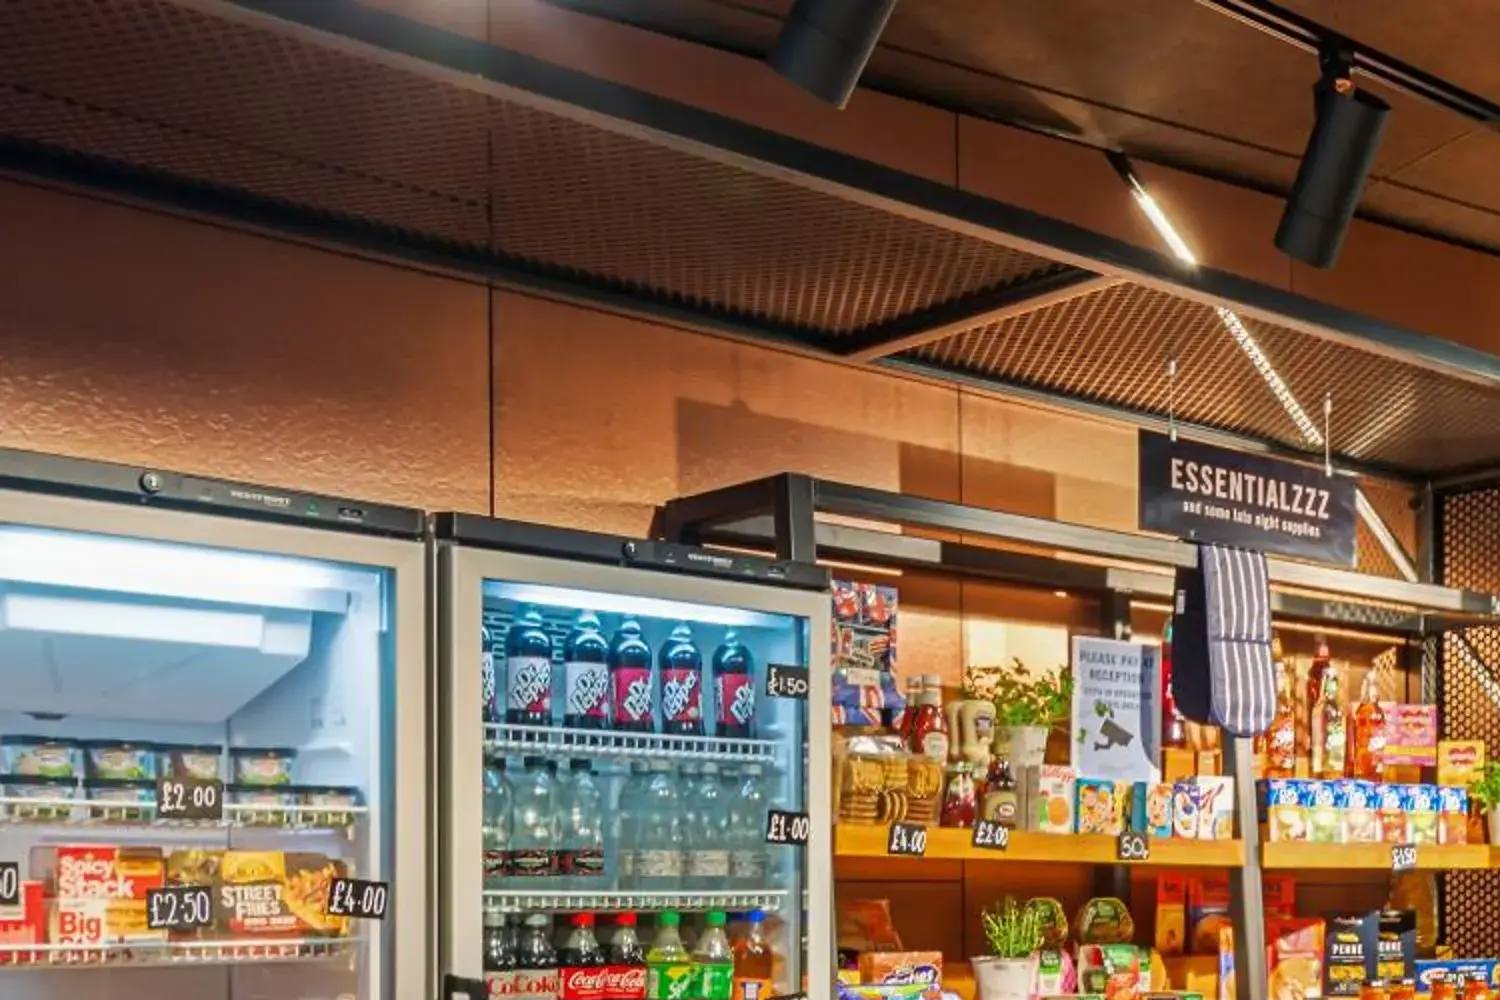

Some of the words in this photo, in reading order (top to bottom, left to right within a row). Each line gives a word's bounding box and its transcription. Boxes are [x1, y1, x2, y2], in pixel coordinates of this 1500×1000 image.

[1171, 458, 1330, 519] ESSENTIALZZZ
[1183, 501, 1202, 515] and
[1205, 504, 1230, 520] some
[1233, 508, 1253, 525] late
[1255, 512, 1280, 531] night
[1281, 519, 1320, 538] supplies
[1080, 650, 1116, 666] PLEASE
[1121, 655, 1139, 667] PAY
[768, 668, 807, 696] £1.50
[160, 783, 216, 813] £2.00
[767, 813, 809, 842] £1.00
[891, 824, 927, 853] £4.00
[60, 855, 117, 880] Spicy
[59, 877, 134, 898] Stack
[221, 885, 283, 907] STREET
[330, 880, 385, 915] £4.00
[149, 892, 210, 928] £2.50
[236, 901, 281, 920] FRIES
[60, 912, 102, 940] Big
